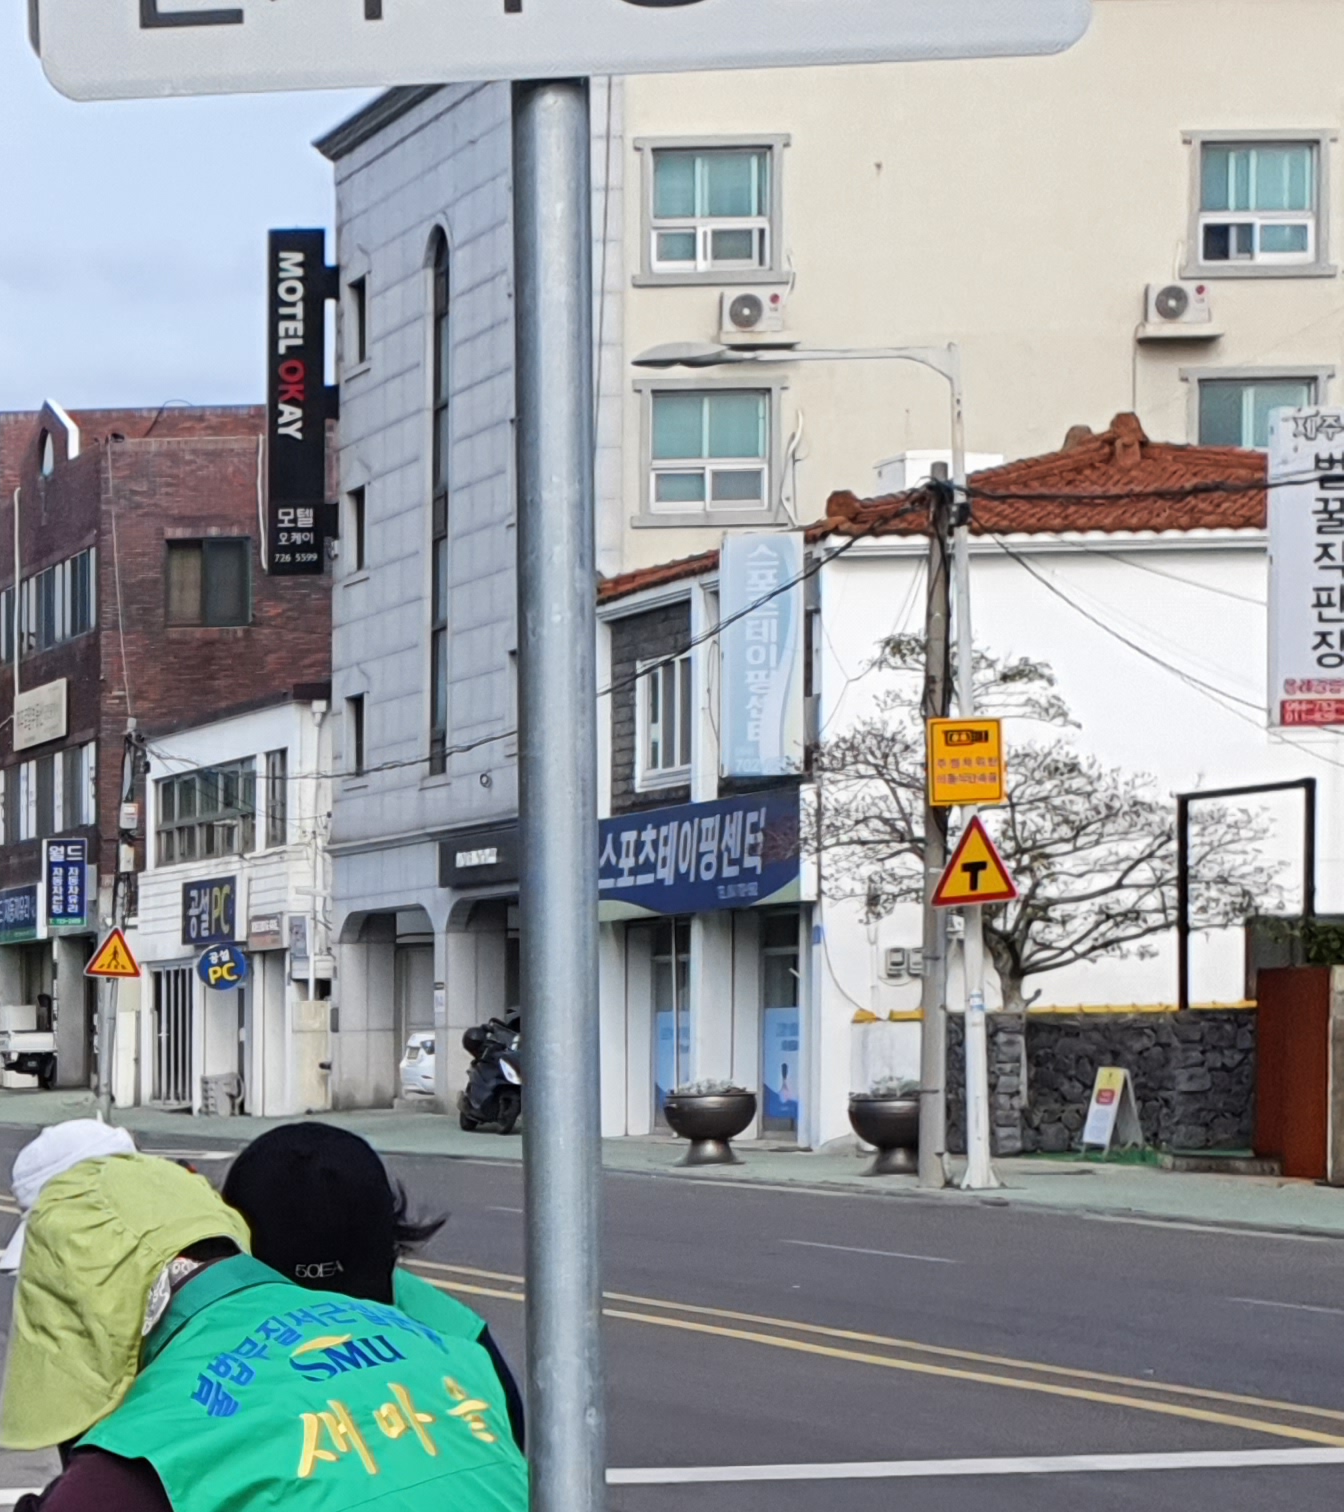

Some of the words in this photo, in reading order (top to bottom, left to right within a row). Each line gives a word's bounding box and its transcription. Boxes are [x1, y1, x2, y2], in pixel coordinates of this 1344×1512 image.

[277, 252, 304, 355] MOTEL
[277, 359, 305, 440] OKAY
[277, 508, 314, 528] 모텔
[277, 532, 314, 545] 오케이
[49, 845, 83, 862] 월드
[598, 807, 767, 889] 스포츠테이핑센터
[188, 888, 210, 939] 공설
[208, 949, 231, 964] 공설
[208, 962, 238, 985] PC
[289, 1334, 408, 1382] SMU
[297, 1374, 499, 1479] 새마을
